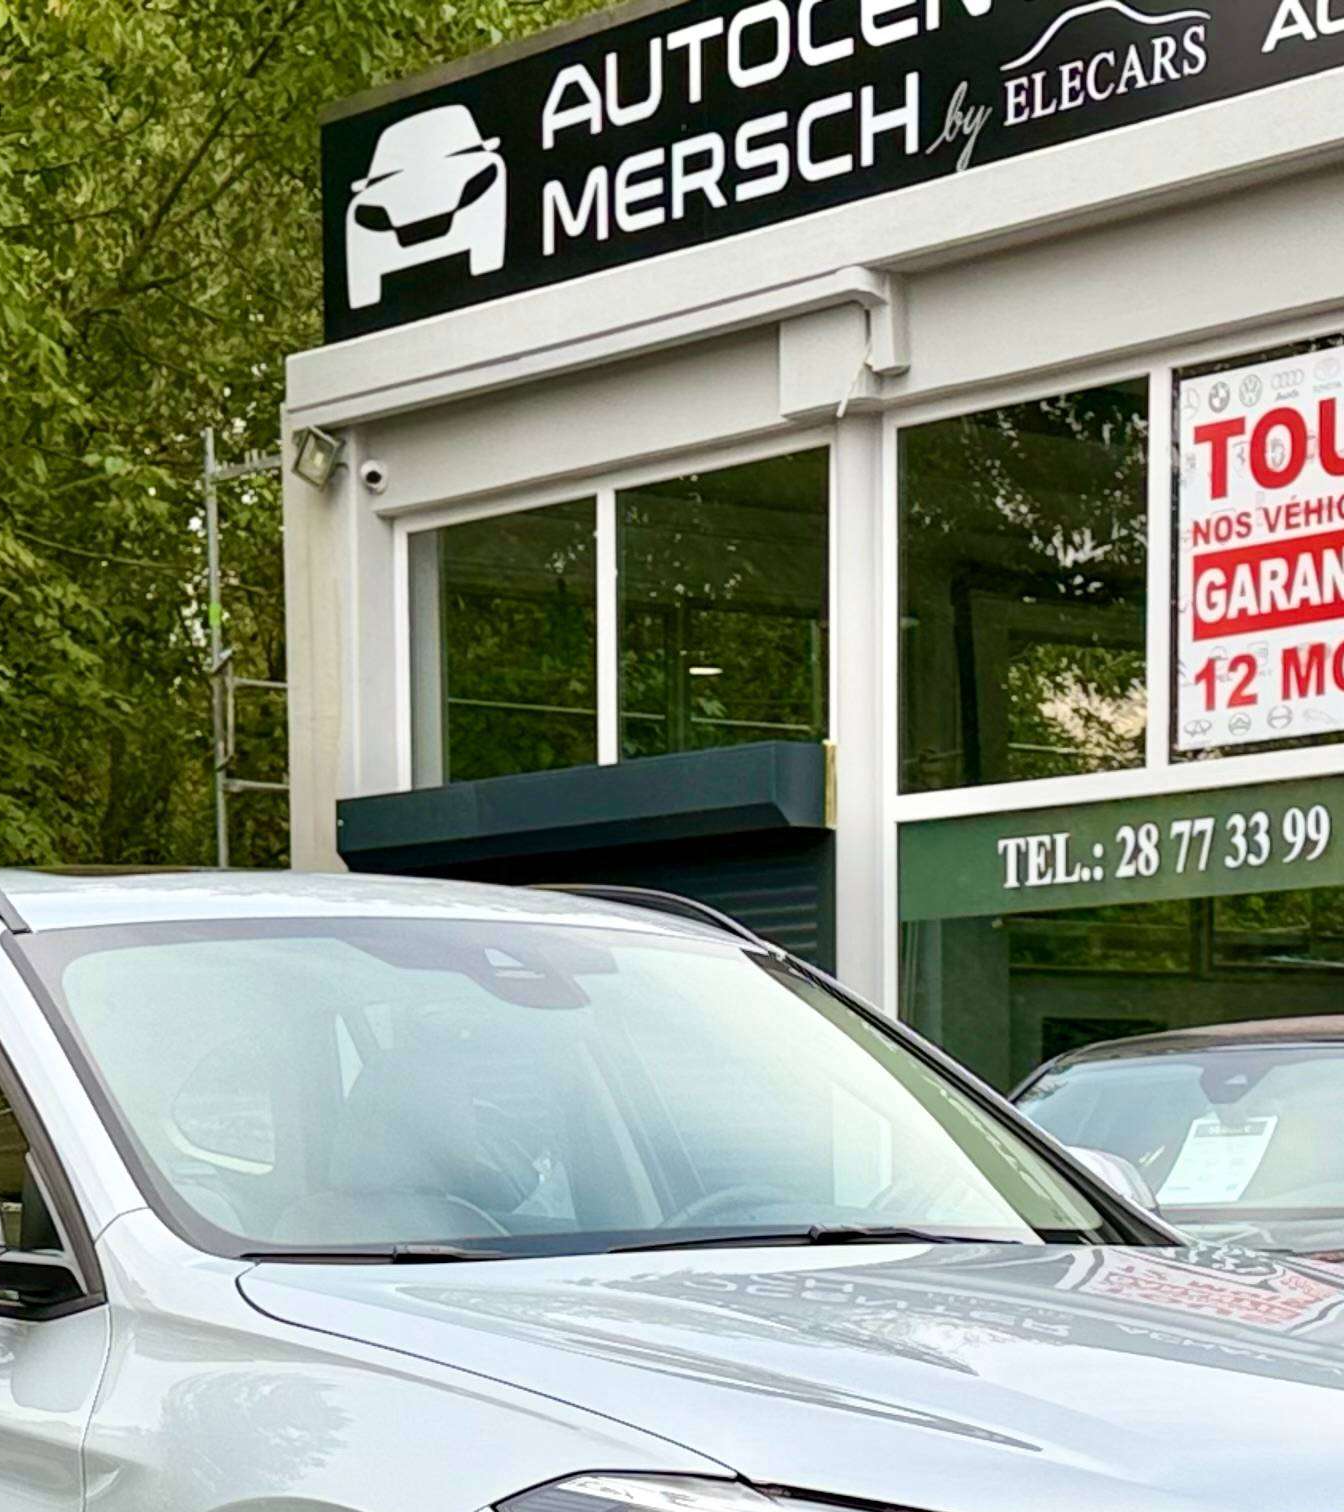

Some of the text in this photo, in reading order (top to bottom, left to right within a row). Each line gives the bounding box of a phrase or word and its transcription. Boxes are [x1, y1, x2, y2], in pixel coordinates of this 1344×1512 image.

[542, 25, 1209, 256] MERSCH by ELECARS
[1192, 512, 1253, 547] NOS
[1194, 653, 1258, 712] 12
[997, 805, 1332, 889] TEL.: 28 77 33 99
